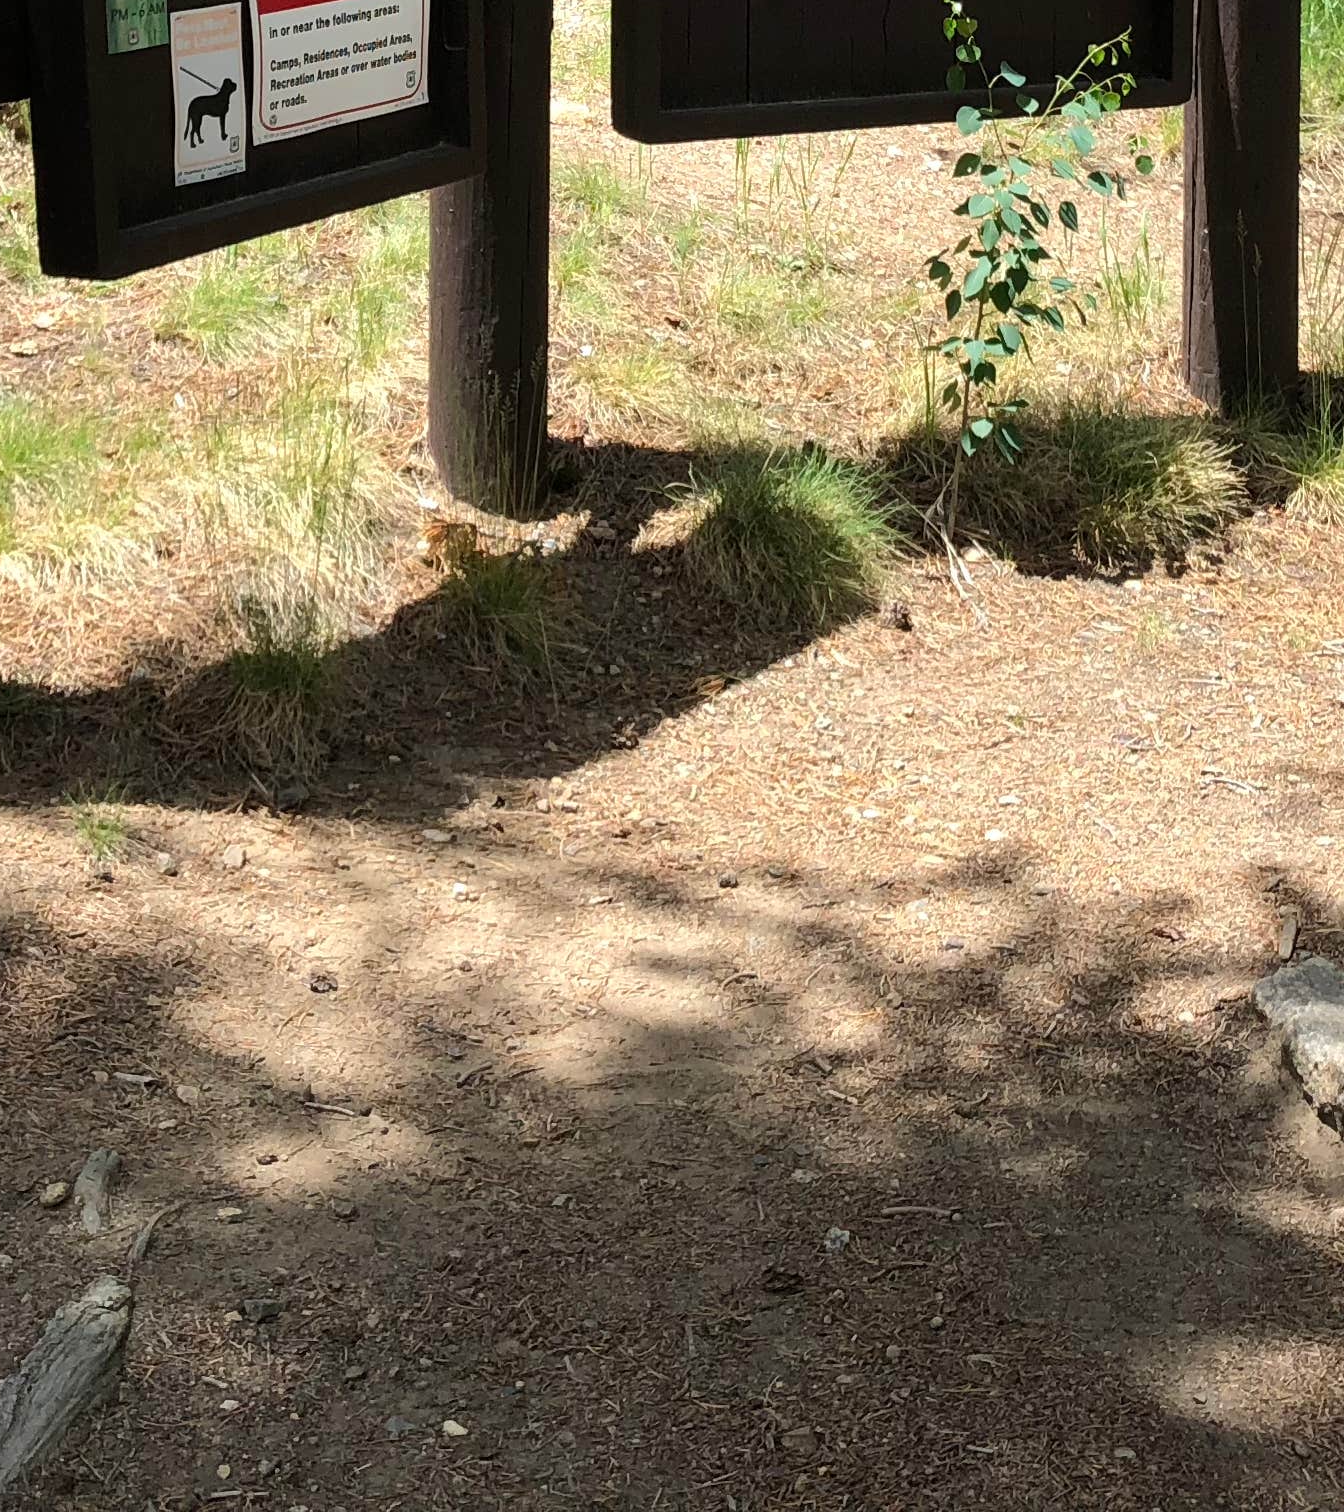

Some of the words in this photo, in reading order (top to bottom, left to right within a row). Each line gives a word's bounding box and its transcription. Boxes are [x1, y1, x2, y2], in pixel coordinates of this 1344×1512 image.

[269, 26, 278, 39] in
[281, 24, 291, 35] or
[293, 21, 313, 35] near
[316, 17, 331, 30] the
[332, 9, 372, 26] following
[374, 4, 400, 18] areas:
[270, 58, 302, 72] Camps,
[304, 46, 351, 65] Residences,
[352, 36, 388, 55] Occupied
[389, 33, 413, 46] Areas,
[270, 72, 315, 92] Recreation
[317, 68, 339, 81] Areas
[341, 65, 350, 76] or
[351, 60, 368, 73] over
[370, 55, 392, 69] water
[393, 49, 417, 64] bodies
[269, 99, 279, 111] or
[281, 93, 308, 108] roads.
